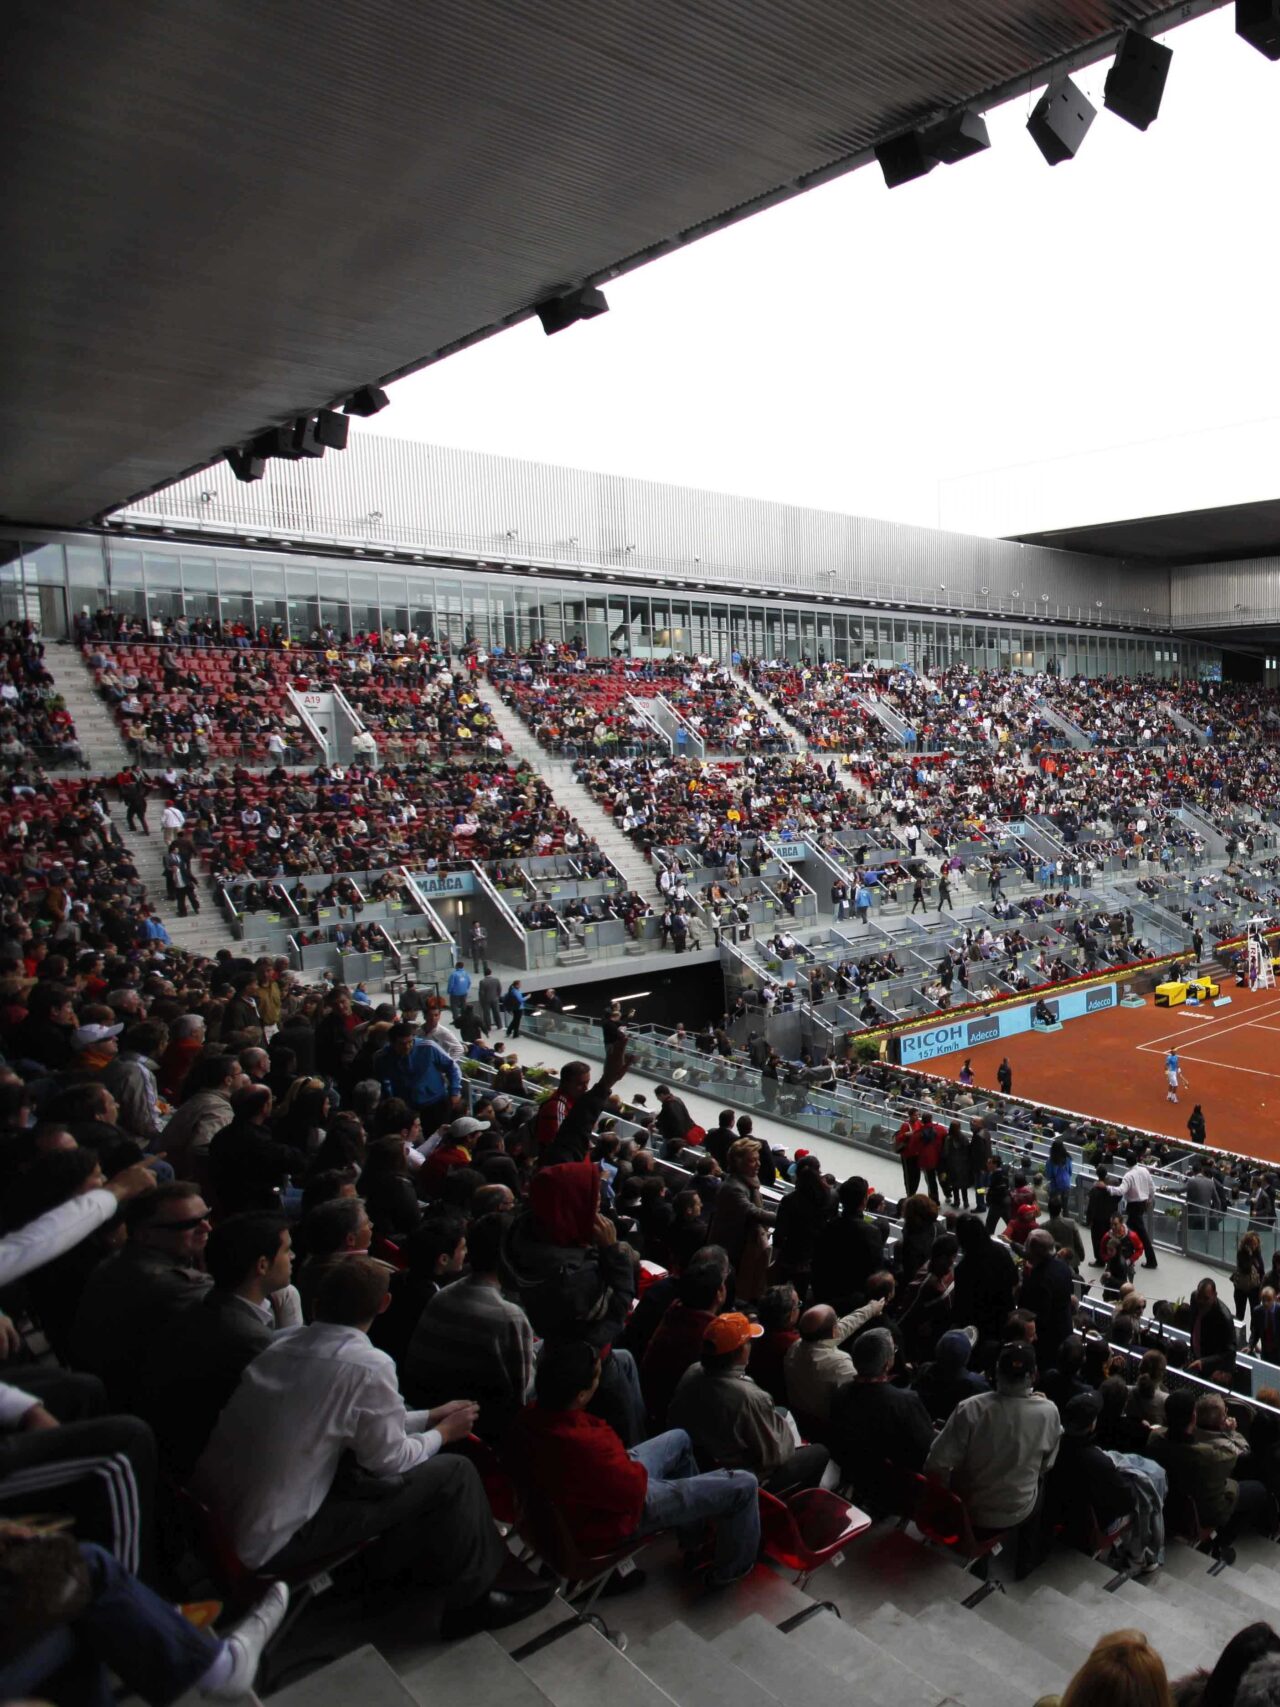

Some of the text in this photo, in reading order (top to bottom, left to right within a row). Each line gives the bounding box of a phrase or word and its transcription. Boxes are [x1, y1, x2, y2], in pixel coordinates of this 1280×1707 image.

[304, 696, 321, 704] A19
[773, 846, 799, 858] ARCA
[1088, 997, 1111, 1011] Adecco
[902, 1025, 963, 1053] RICOH
[970, 1028, 998, 1044] Adecco
[917, 1042, 960, 1060] 157 Km/h
